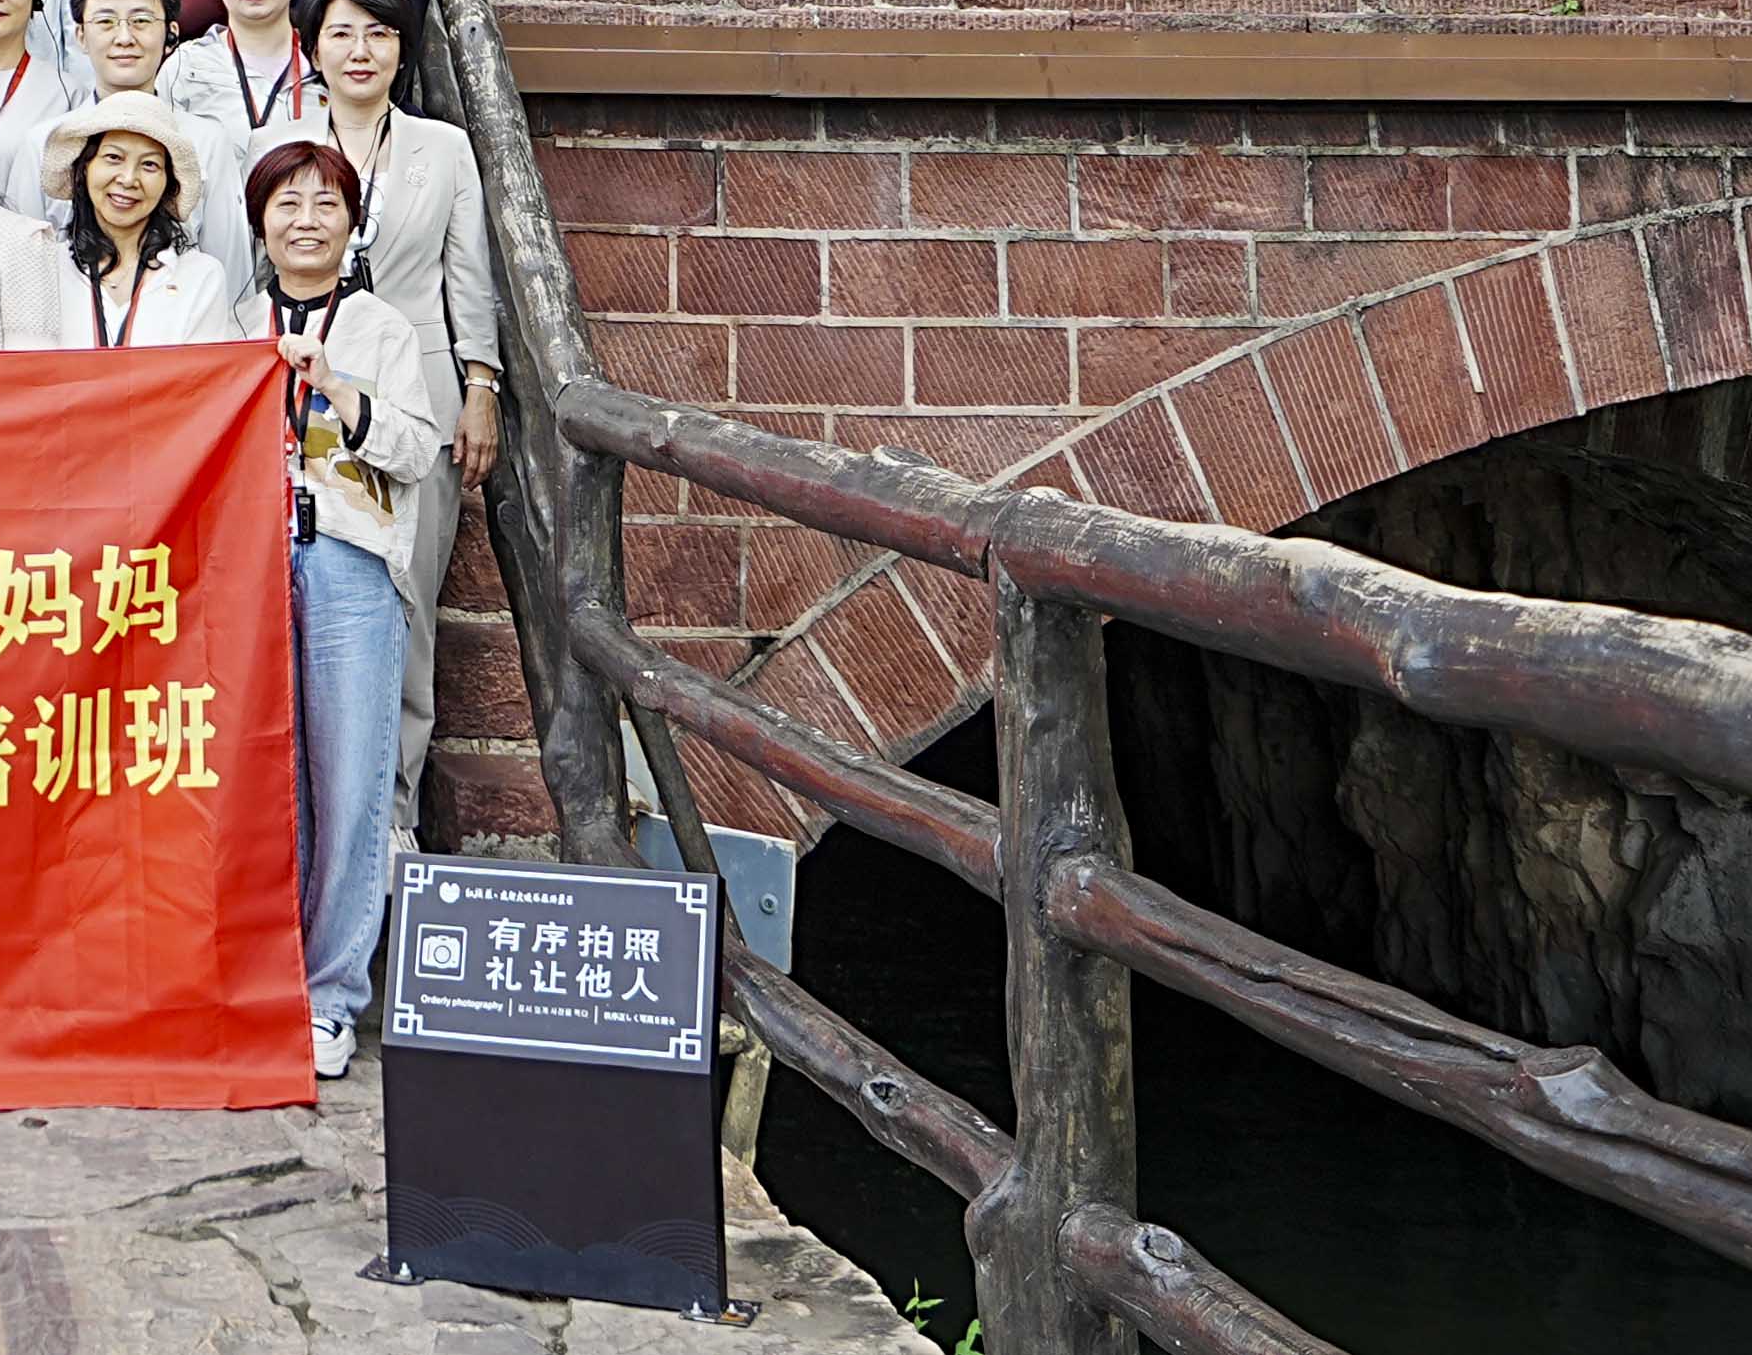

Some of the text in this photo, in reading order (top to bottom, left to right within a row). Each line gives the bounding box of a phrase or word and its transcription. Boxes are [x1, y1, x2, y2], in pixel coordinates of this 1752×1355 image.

[487, 917, 662, 963] 有序拍照
[484, 955, 660, 1003] 礼让他人
[420, 993, 504, 1013] Orderly photography
